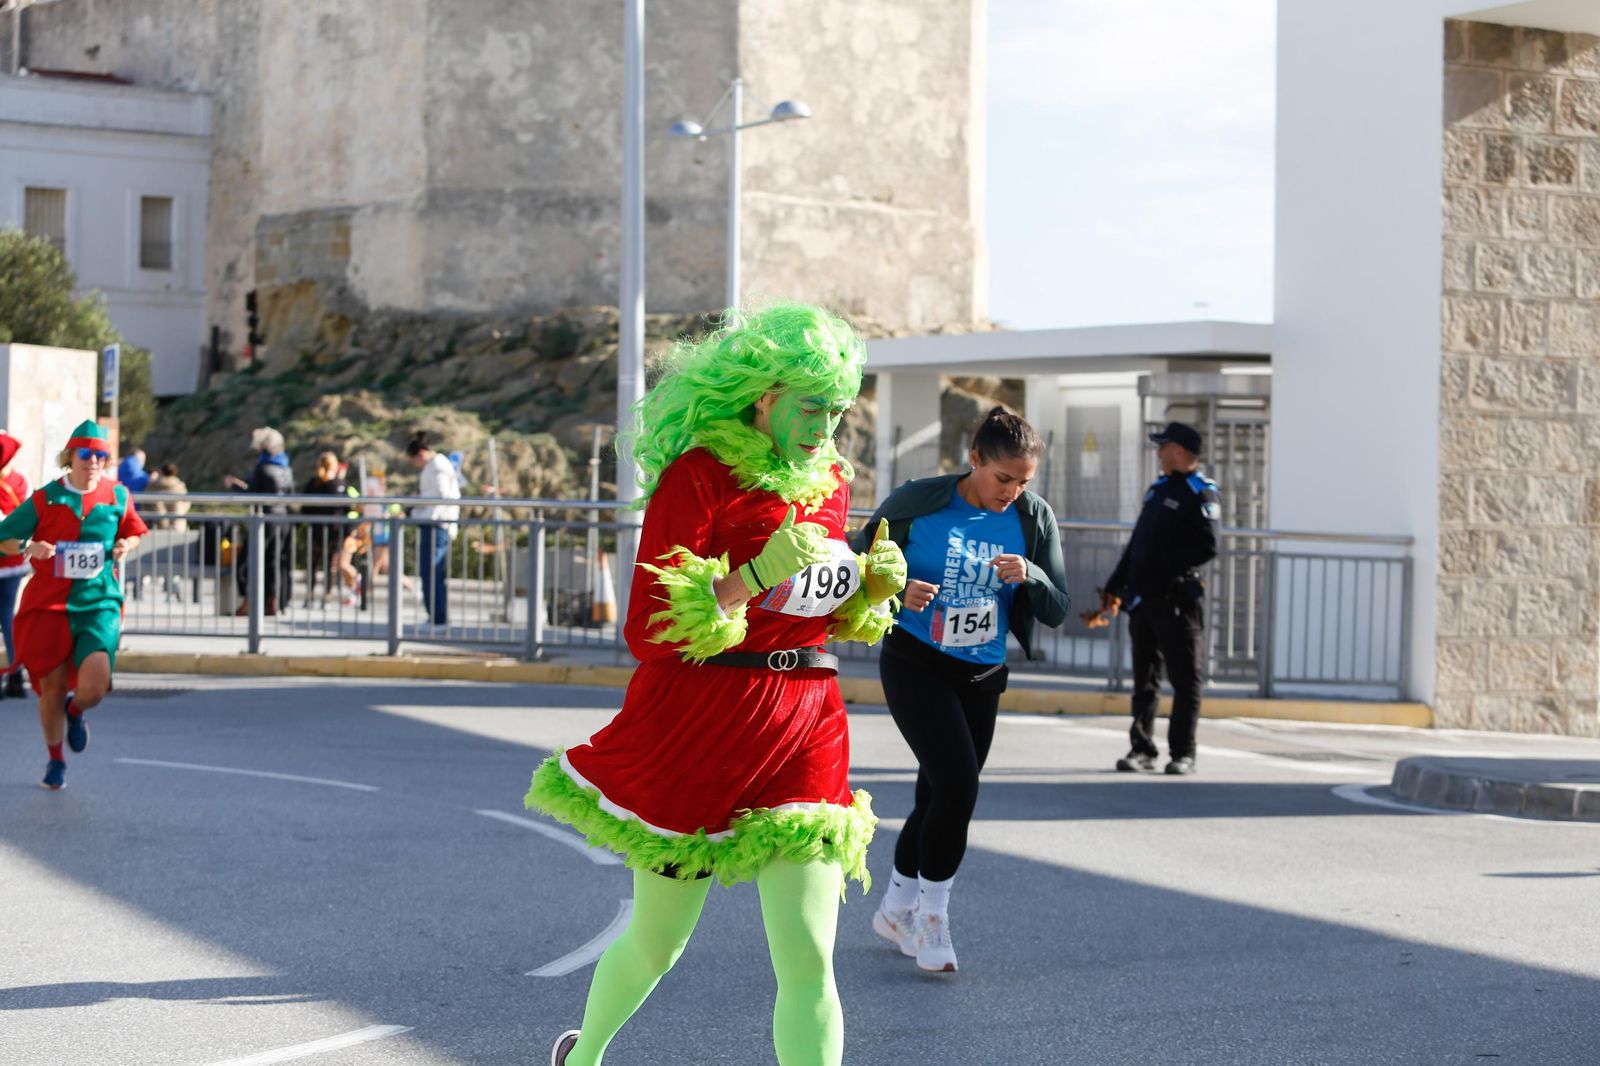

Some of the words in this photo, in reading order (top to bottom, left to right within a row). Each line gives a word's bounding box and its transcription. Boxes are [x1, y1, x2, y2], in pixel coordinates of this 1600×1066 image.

[966, 539, 1004, 560] SAN
[68, 553, 98, 569] 183
[942, 537, 962, 597] ARRERA
[800, 565, 851, 599] 198
[952, 594, 998, 606] CARR
[949, 611, 991, 634] 154
